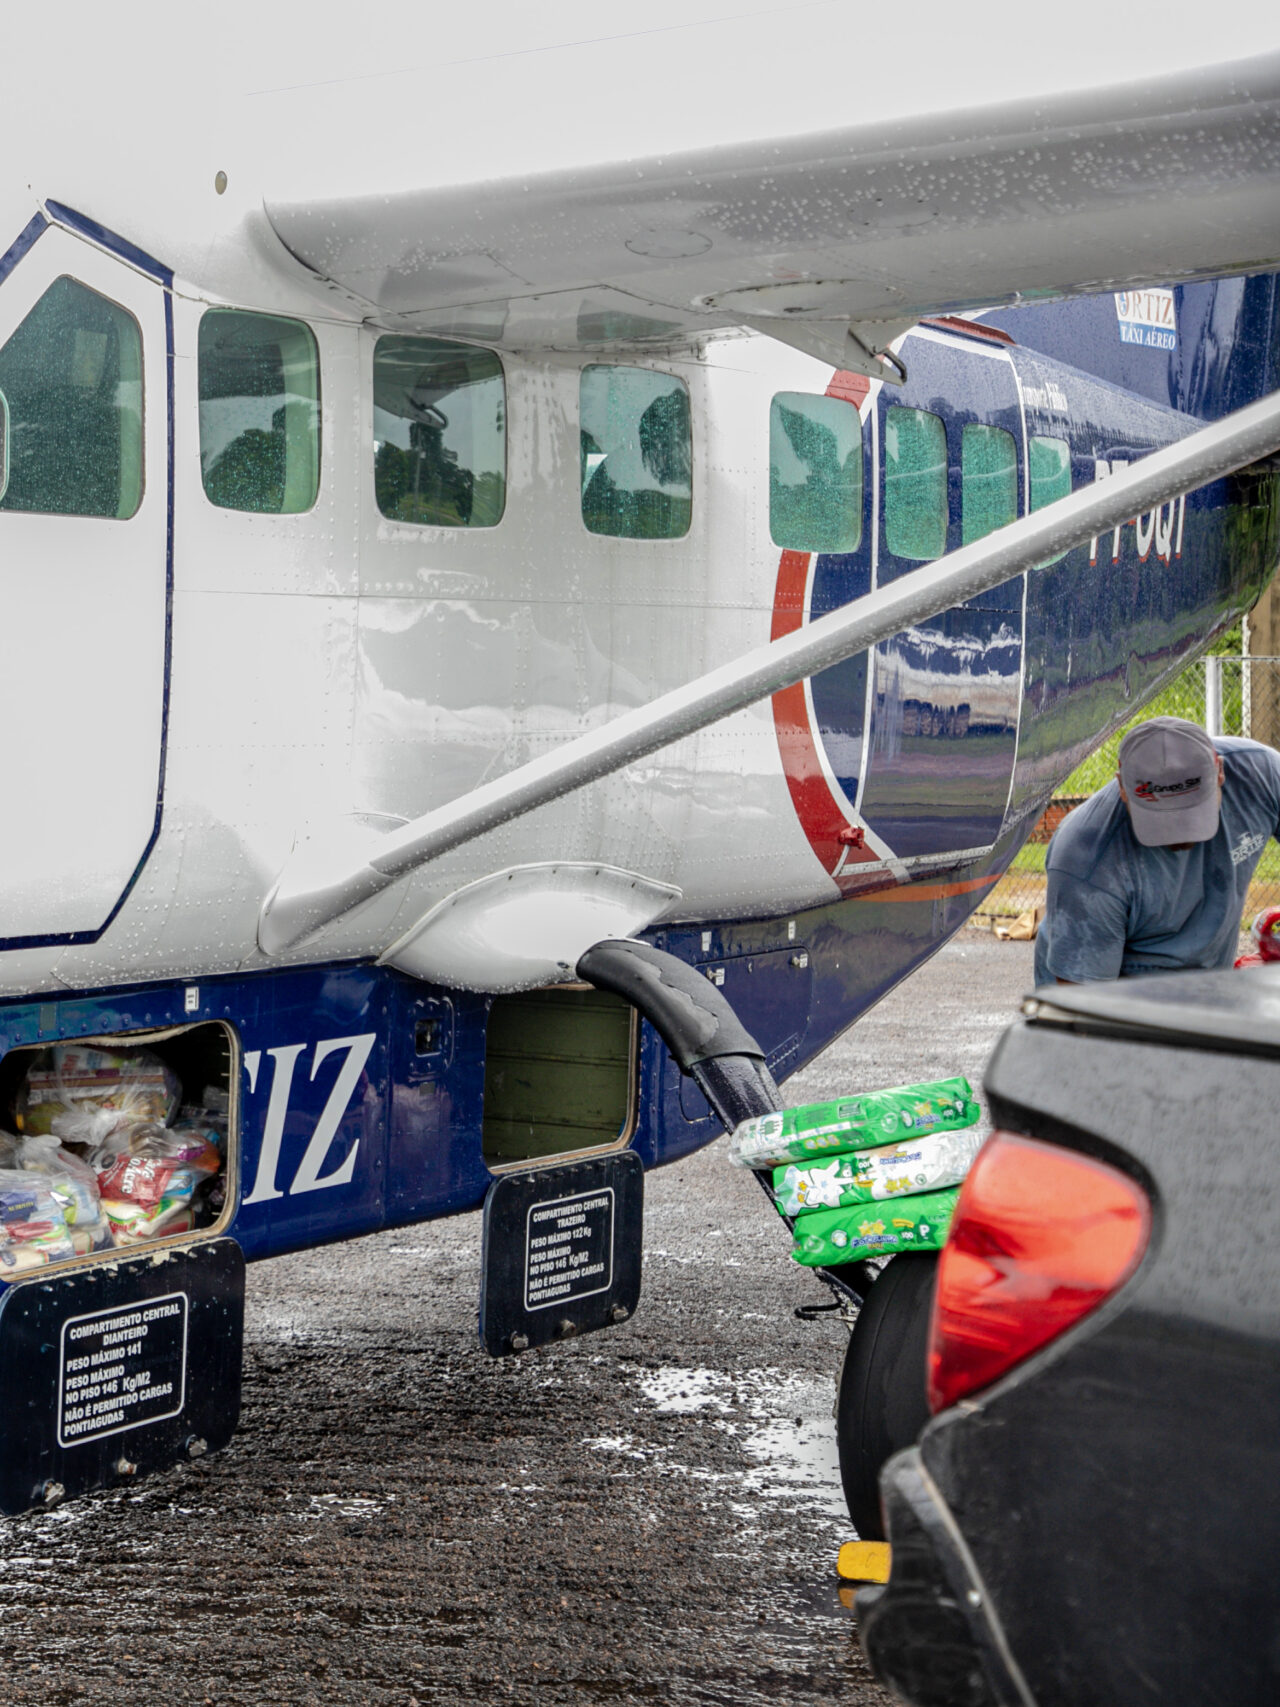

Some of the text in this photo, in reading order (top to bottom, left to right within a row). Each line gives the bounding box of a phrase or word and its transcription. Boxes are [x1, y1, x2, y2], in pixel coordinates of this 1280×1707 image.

[1118, 290, 1172, 324] ORTIZ
[1120, 322, 1176, 350] TÁXI AÉREO
[533, 1197, 608, 1222] COMPARTIMENTO CENTRAL
[557, 1214, 586, 1228] TRAZEIRO
[531, 1227, 592, 1248] PESO MÁXIMO 122 Kg
[919, 1224, 930, 1237] P
[530, 1246, 571, 1264] PESO MÁXIMO
[530, 1264, 539, 1275] NO
[540, 1261, 554, 1272] PISO
[530, 1263, 604, 1290] NÃO É PERMITIDO CARGAS
[529, 1284, 570, 1302] PONTIAGUDAS
[70, 1304, 180, 1339] COMPARTIMENTO CENTRAL
[103, 1325, 148, 1345] DIANTEIRO
[67, 1341, 141, 1372] PESO MÁXIMO 141
[66, 1365, 124, 1390] PESO MÁXIMO
[66, 1371, 150, 1404] NO PISO 146 Kg/M2
[65, 1383, 173, 1422] NÃO É PERMITIDO CARGAS
[64, 1410, 124, 1436] PONTIAGUDAS
